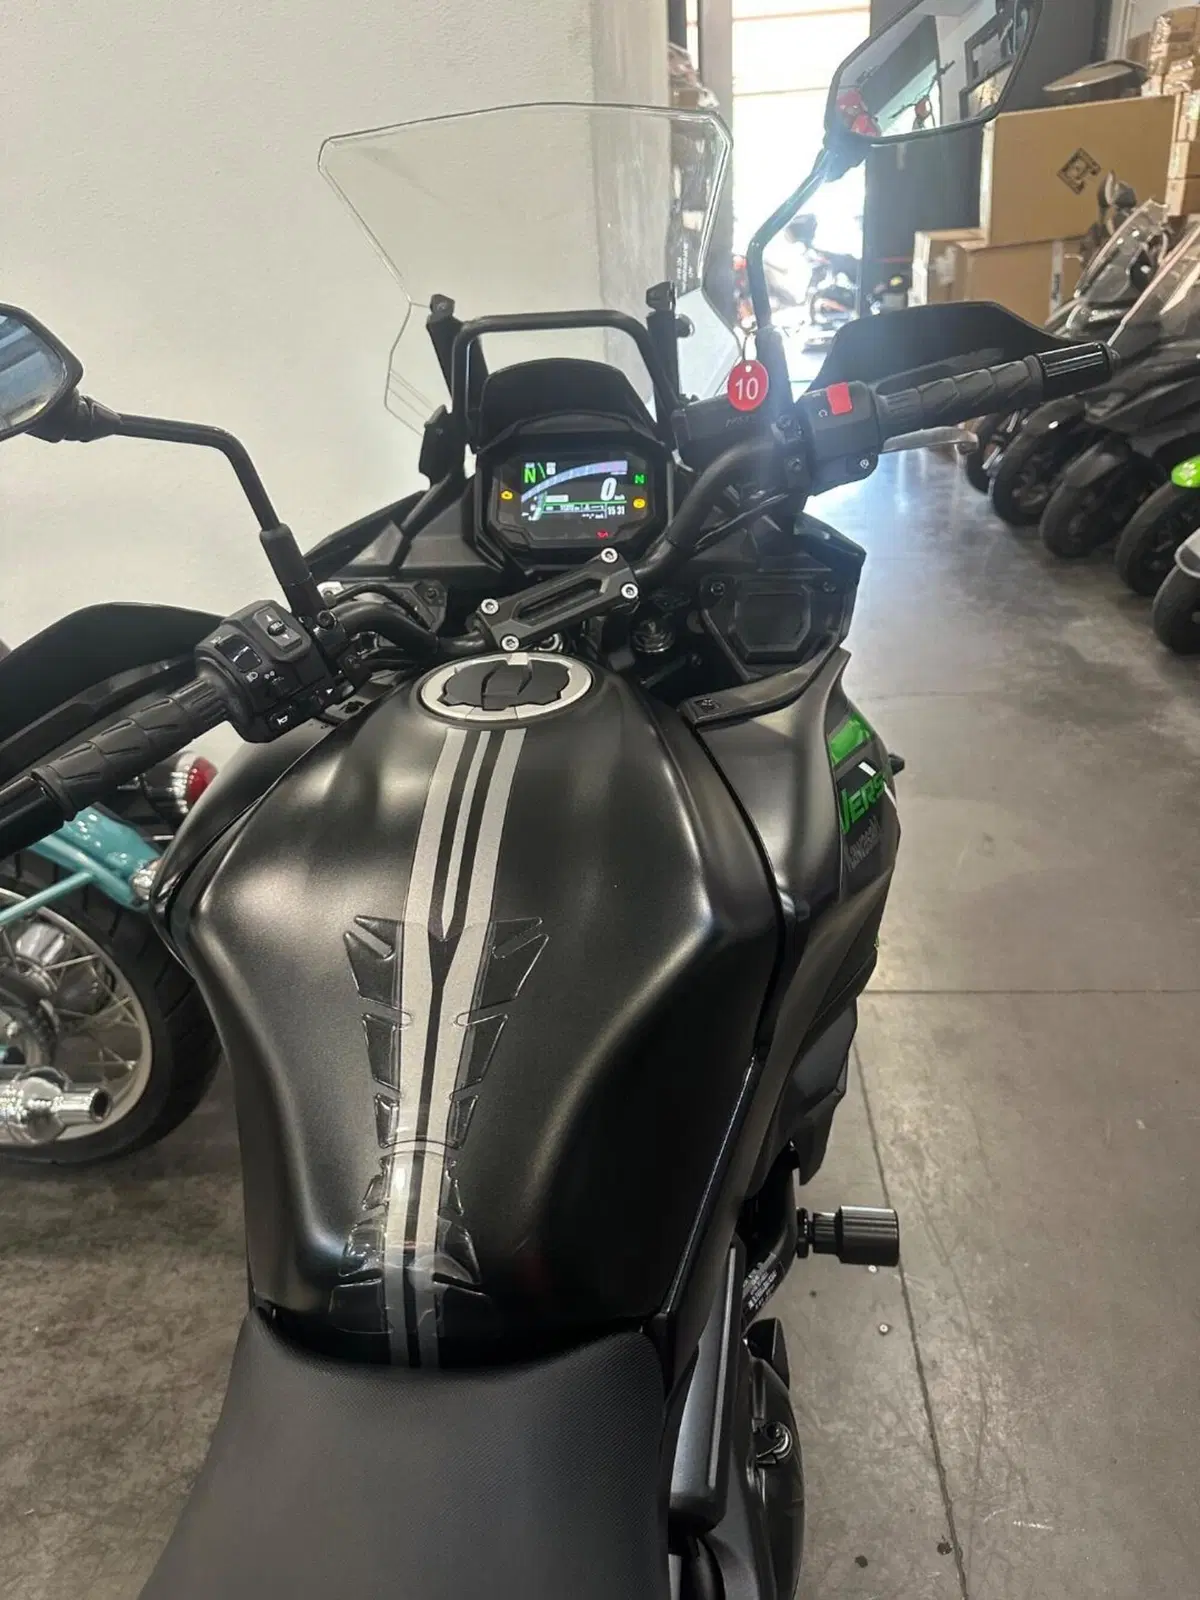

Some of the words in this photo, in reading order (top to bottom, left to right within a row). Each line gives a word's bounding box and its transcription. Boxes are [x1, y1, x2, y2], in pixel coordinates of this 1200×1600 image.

[735, 376, 759, 401] 10
[524, 467, 537, 484] N
[634, 474, 645, 485] N
[600, 477, 618, 501] 0
